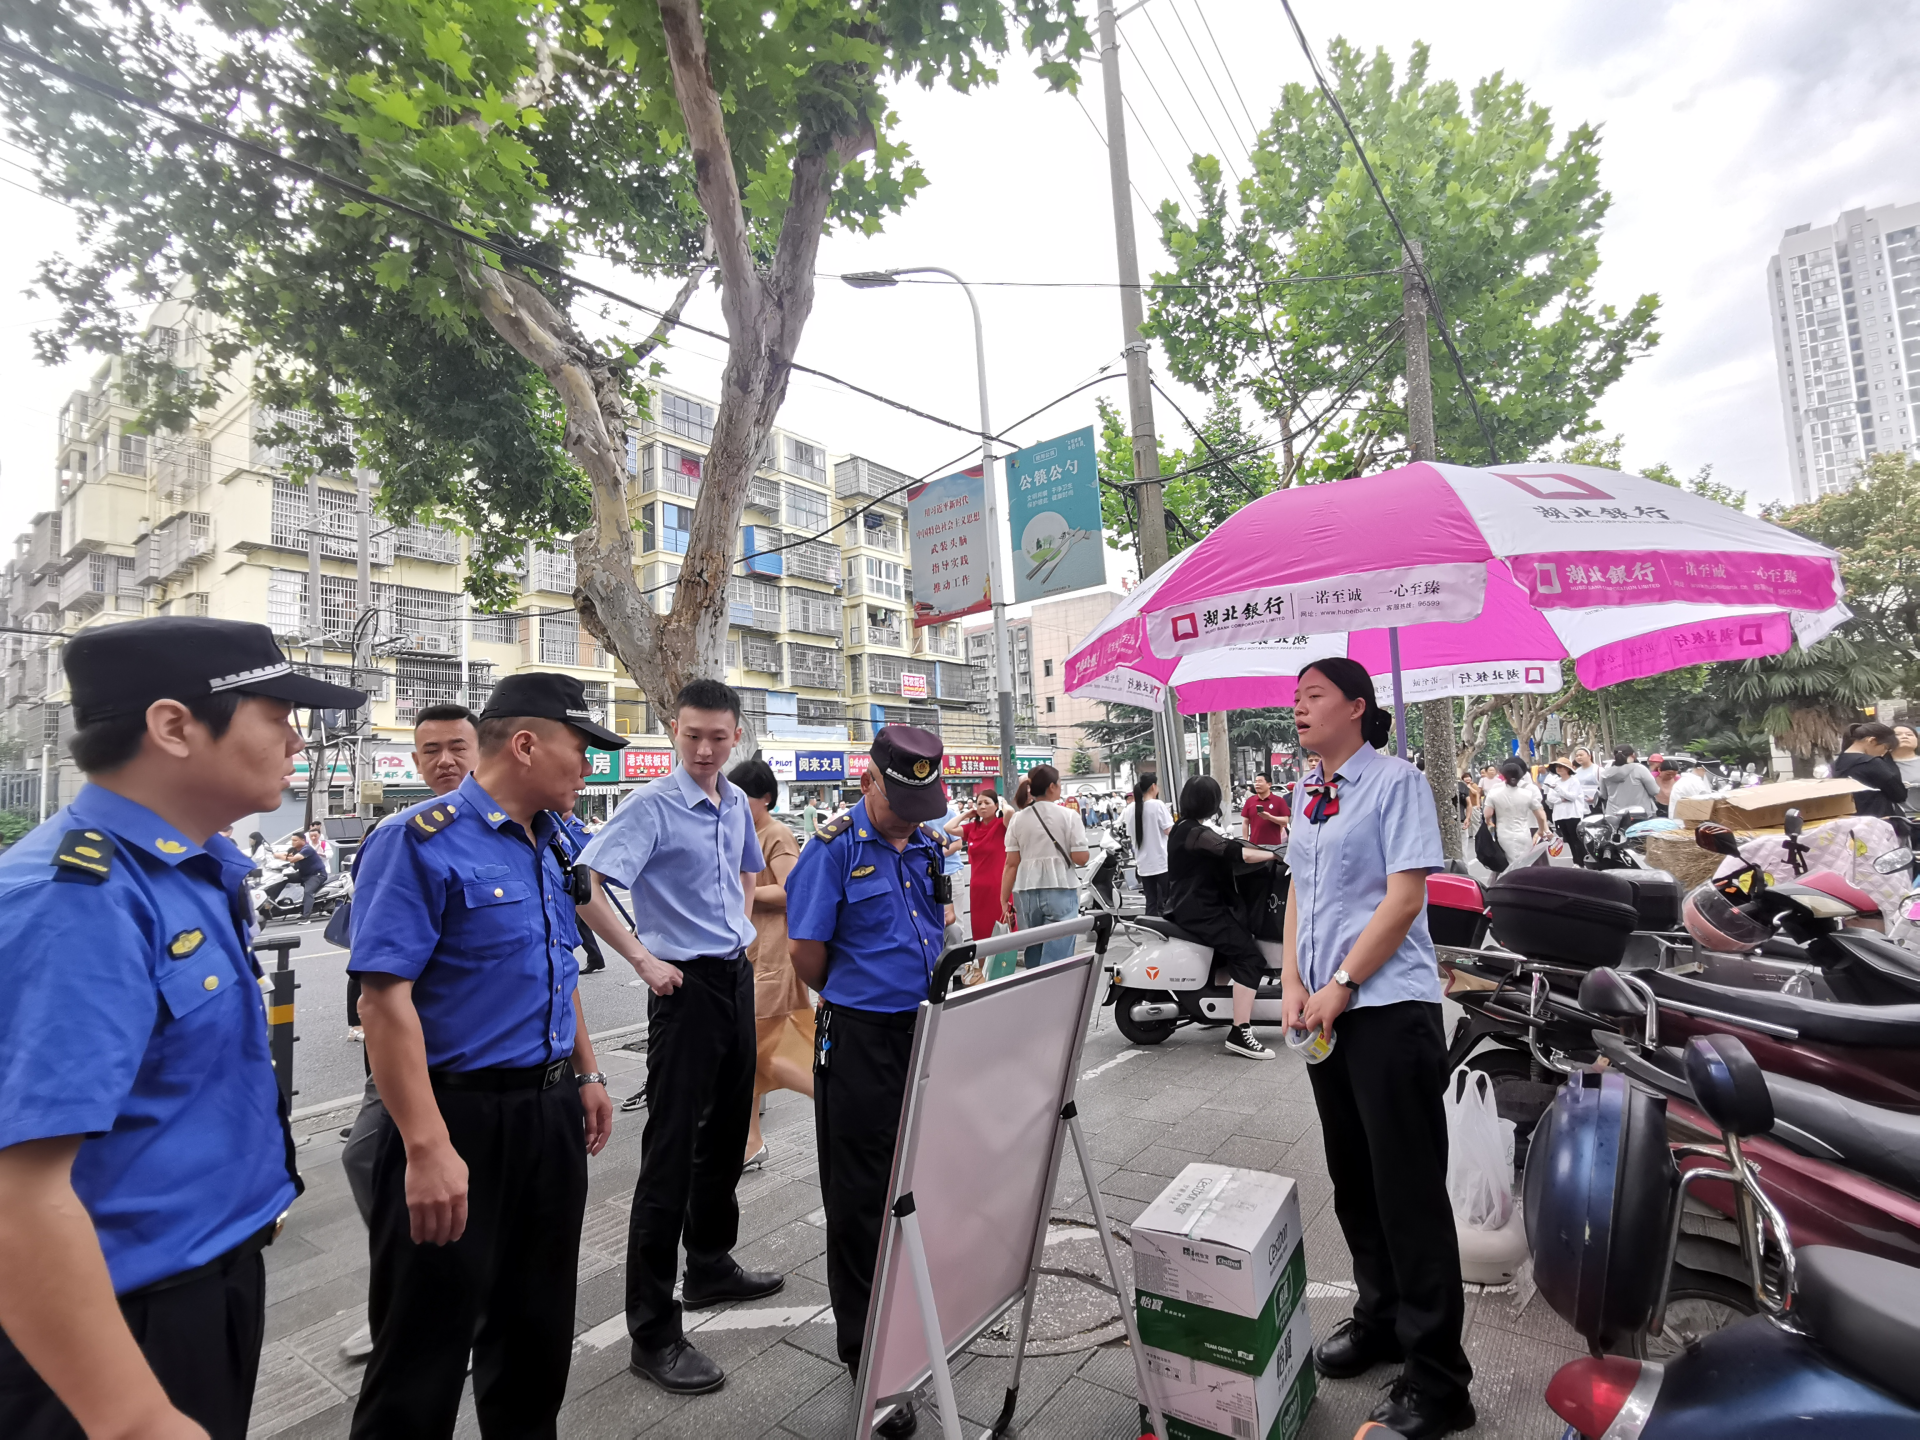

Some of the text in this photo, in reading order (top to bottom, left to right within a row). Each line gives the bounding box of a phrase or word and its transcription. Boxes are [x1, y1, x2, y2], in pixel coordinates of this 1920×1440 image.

[1019, 460, 1078, 490] 公筷公勺
[924, 495, 969, 517] 用习近平新时代
[916, 511, 980, 539] 中国特色社会主义思想
[931, 535, 967, 555] 武装头脑
[932, 555, 969, 574] 指导实践
[933, 575, 970, 593] 推动工作
[1300, 588, 1362, 604] 一诺至诚
[1378, 580, 1440, 598] 一心至臻
[1231, 619, 1265, 629] CORPORATION
[1265, 616, 1285, 624] LIMITED
[585, 752, 611, 774] 房
[627, 754, 669, 766] 港式铁板饭
